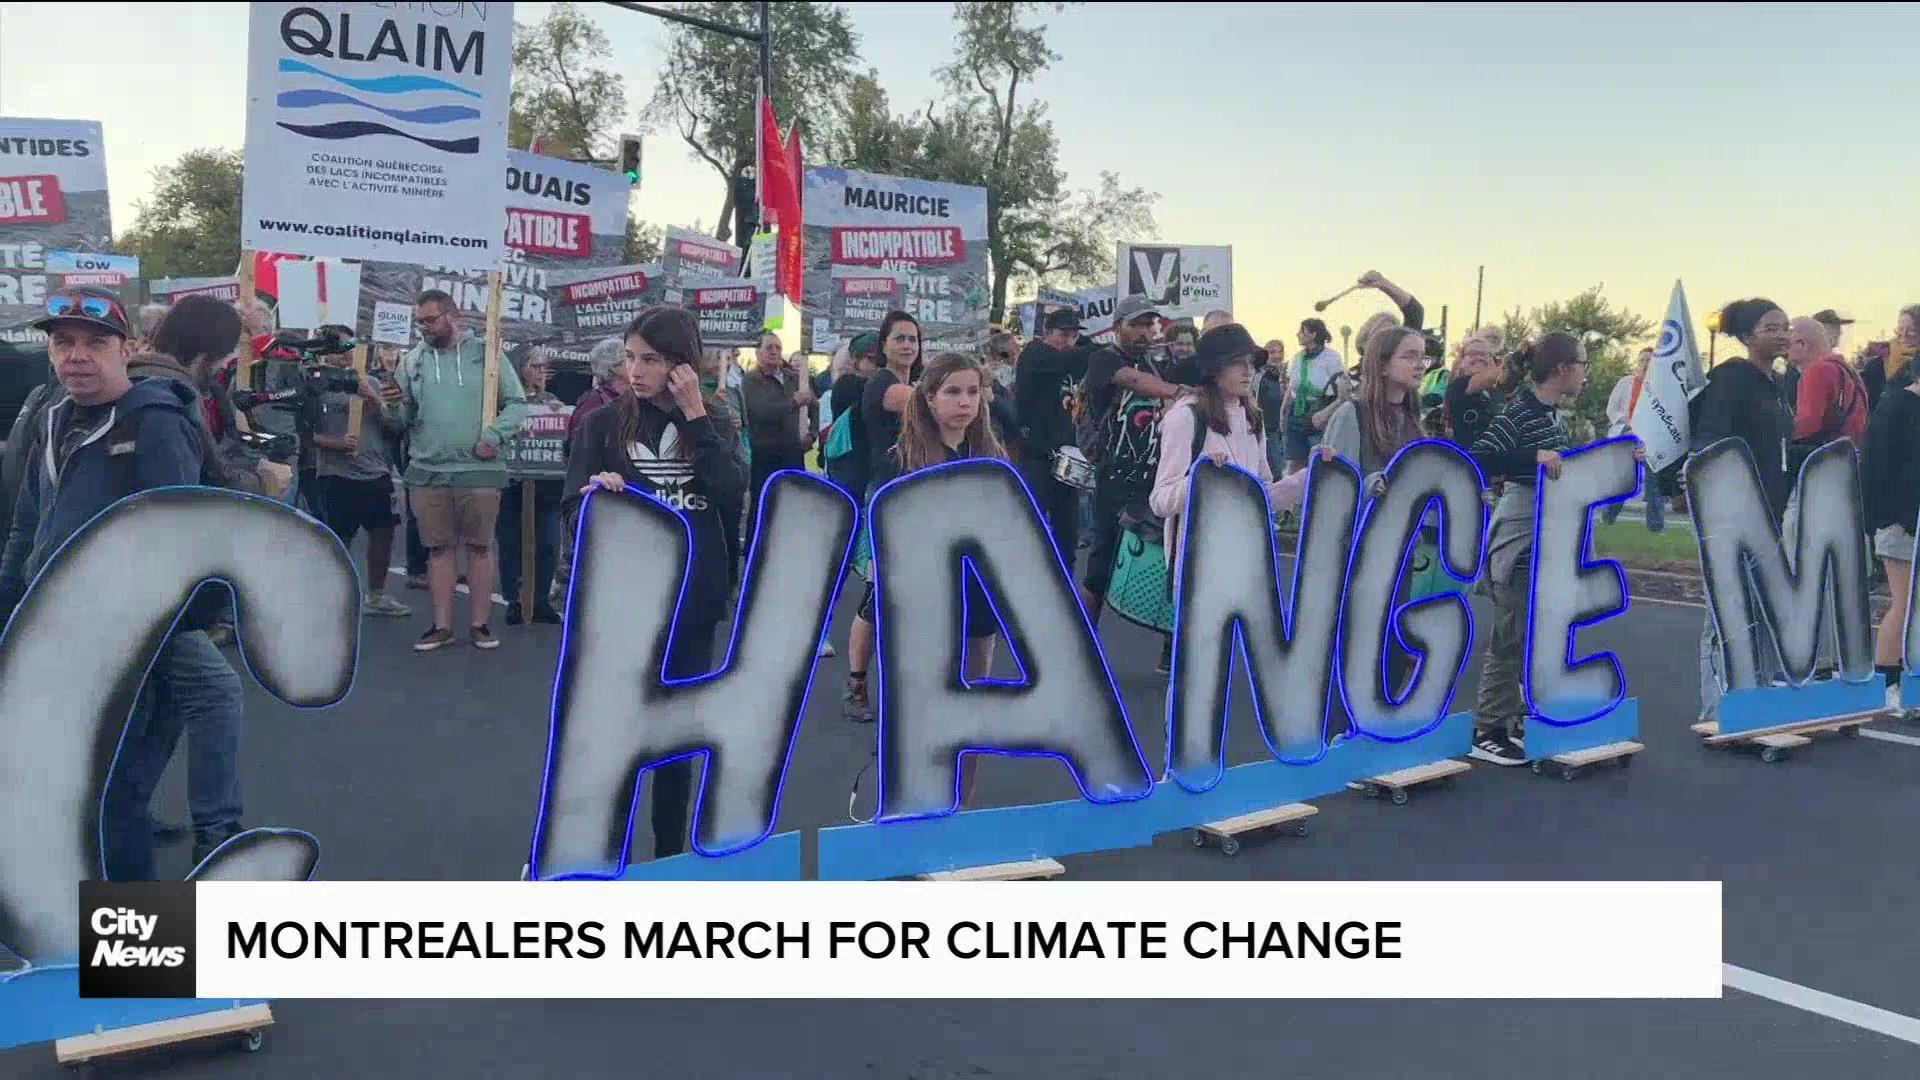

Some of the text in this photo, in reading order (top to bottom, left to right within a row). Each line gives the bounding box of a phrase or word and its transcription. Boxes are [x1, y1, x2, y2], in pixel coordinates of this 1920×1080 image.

[280, 7, 485, 75] QLAIM
[312, 153, 373, 168] COALITION
[307, 165, 448, 187] DES LACS INCOMPATIBLES
[308, 177, 340, 189] AVEC
[844, 186, 950, 217] MAURICIE
[259, 218, 488, 249] www.coalitionqlaim.com
[505, 211, 579, 250] ATIBLE
[841, 230, 955, 258] INCOMPATIBLE
[76, 259, 110, 270] LOW
[880, 260, 918, 274] AVEC
[570, 275, 641, 299] INCOMPATIBLE
[1183, 274, 1211, 284] Vent
